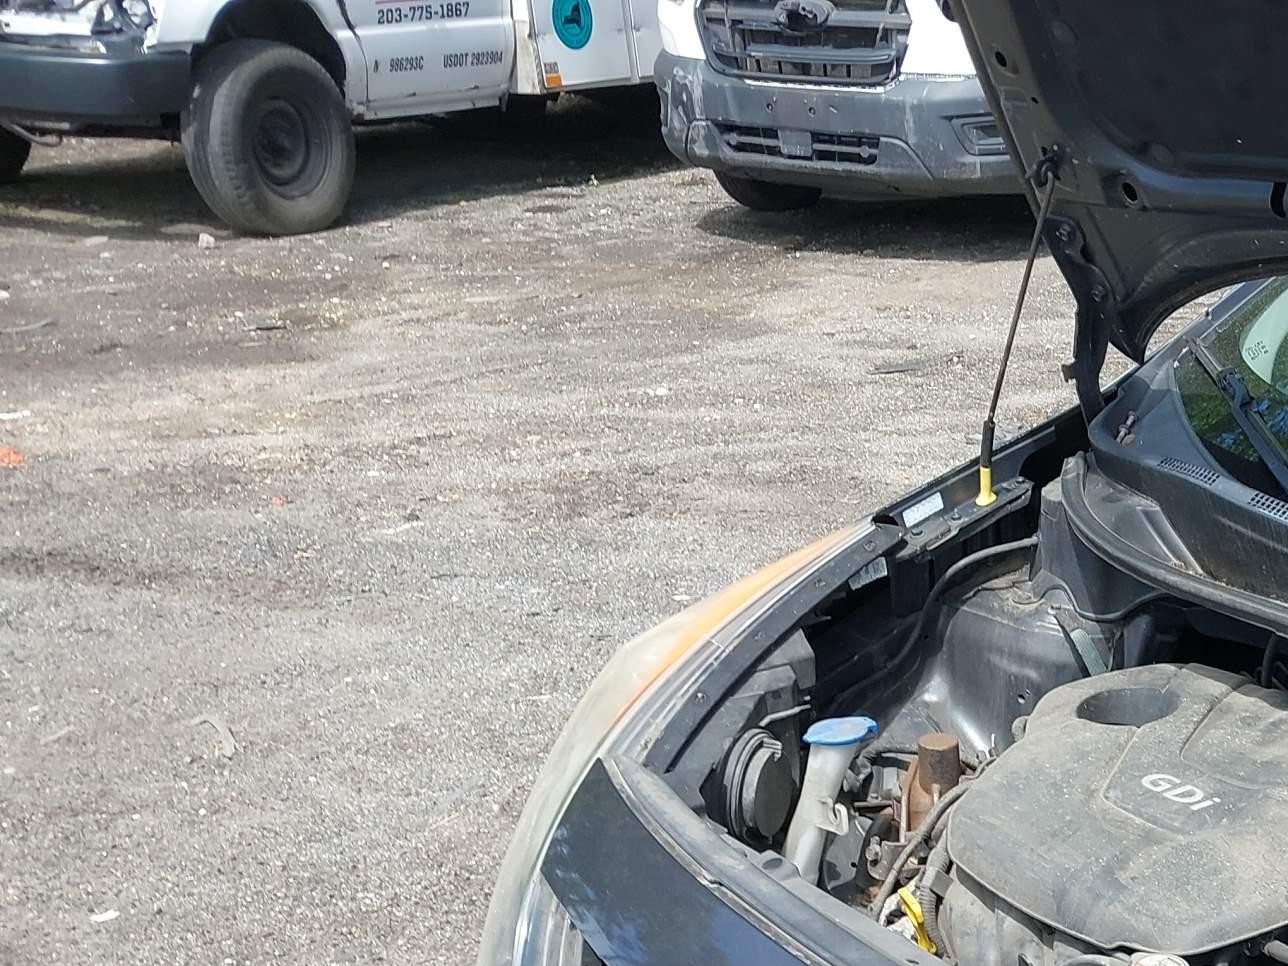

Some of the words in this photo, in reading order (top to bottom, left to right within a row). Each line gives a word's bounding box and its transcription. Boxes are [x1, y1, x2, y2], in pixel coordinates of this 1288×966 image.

[377, 2, 470, 25] 203-775-1867
[389, 56, 424, 72] 986293C
[443, 52, 469, 69] USDOT
